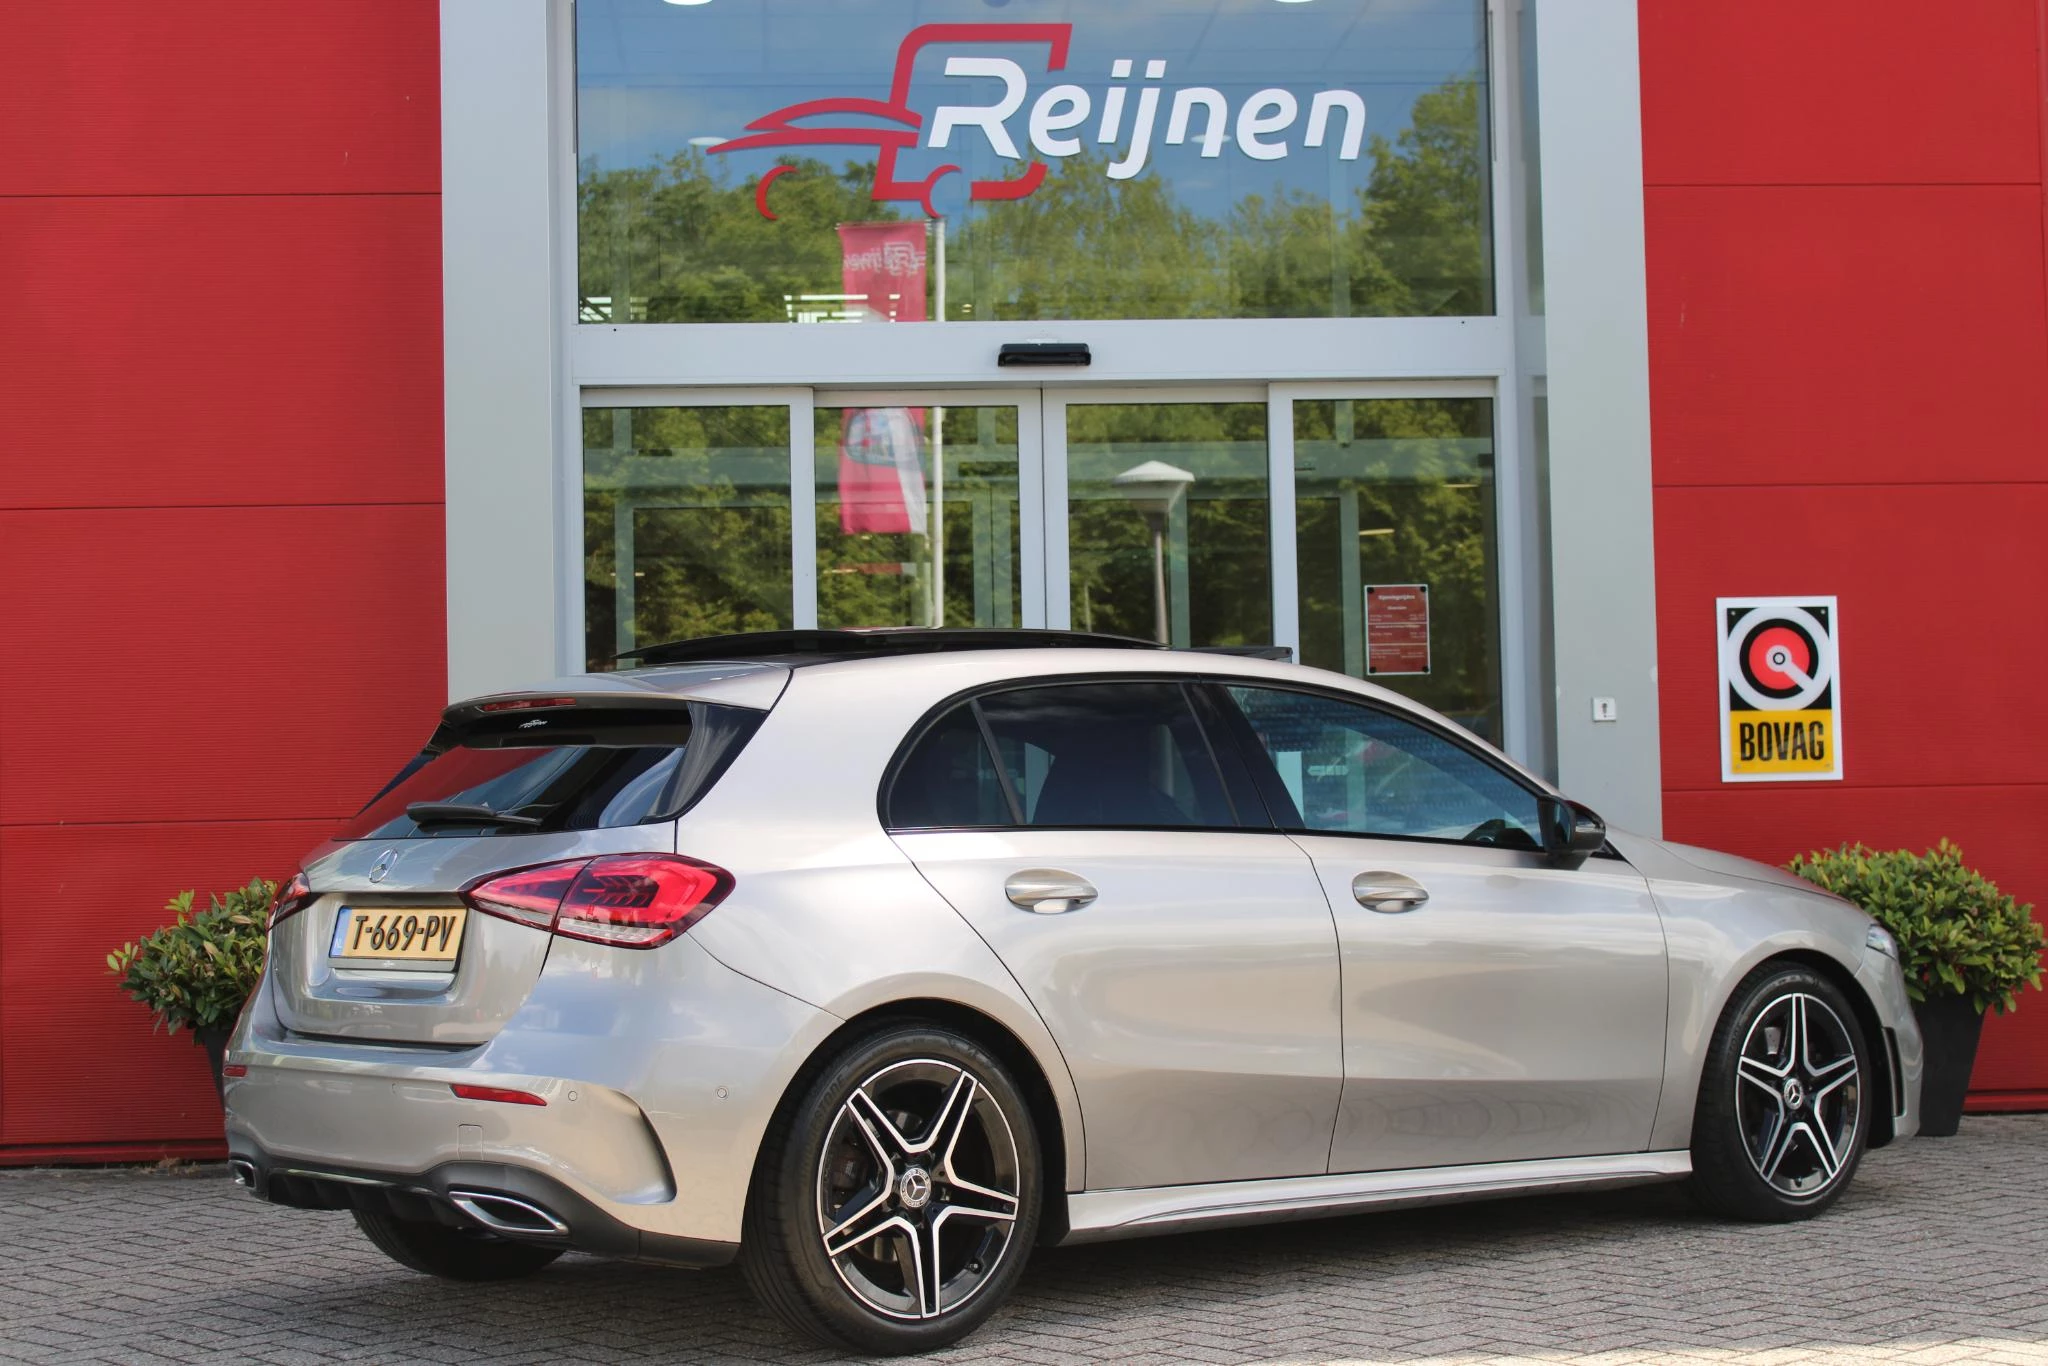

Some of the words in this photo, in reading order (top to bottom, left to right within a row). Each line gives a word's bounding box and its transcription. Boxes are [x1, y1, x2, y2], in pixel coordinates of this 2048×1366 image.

[928, 57, 1366, 180] Reijnen
[1739, 721, 1824, 761] BOVAG
[352, 915, 456, 952] T-669-PV
